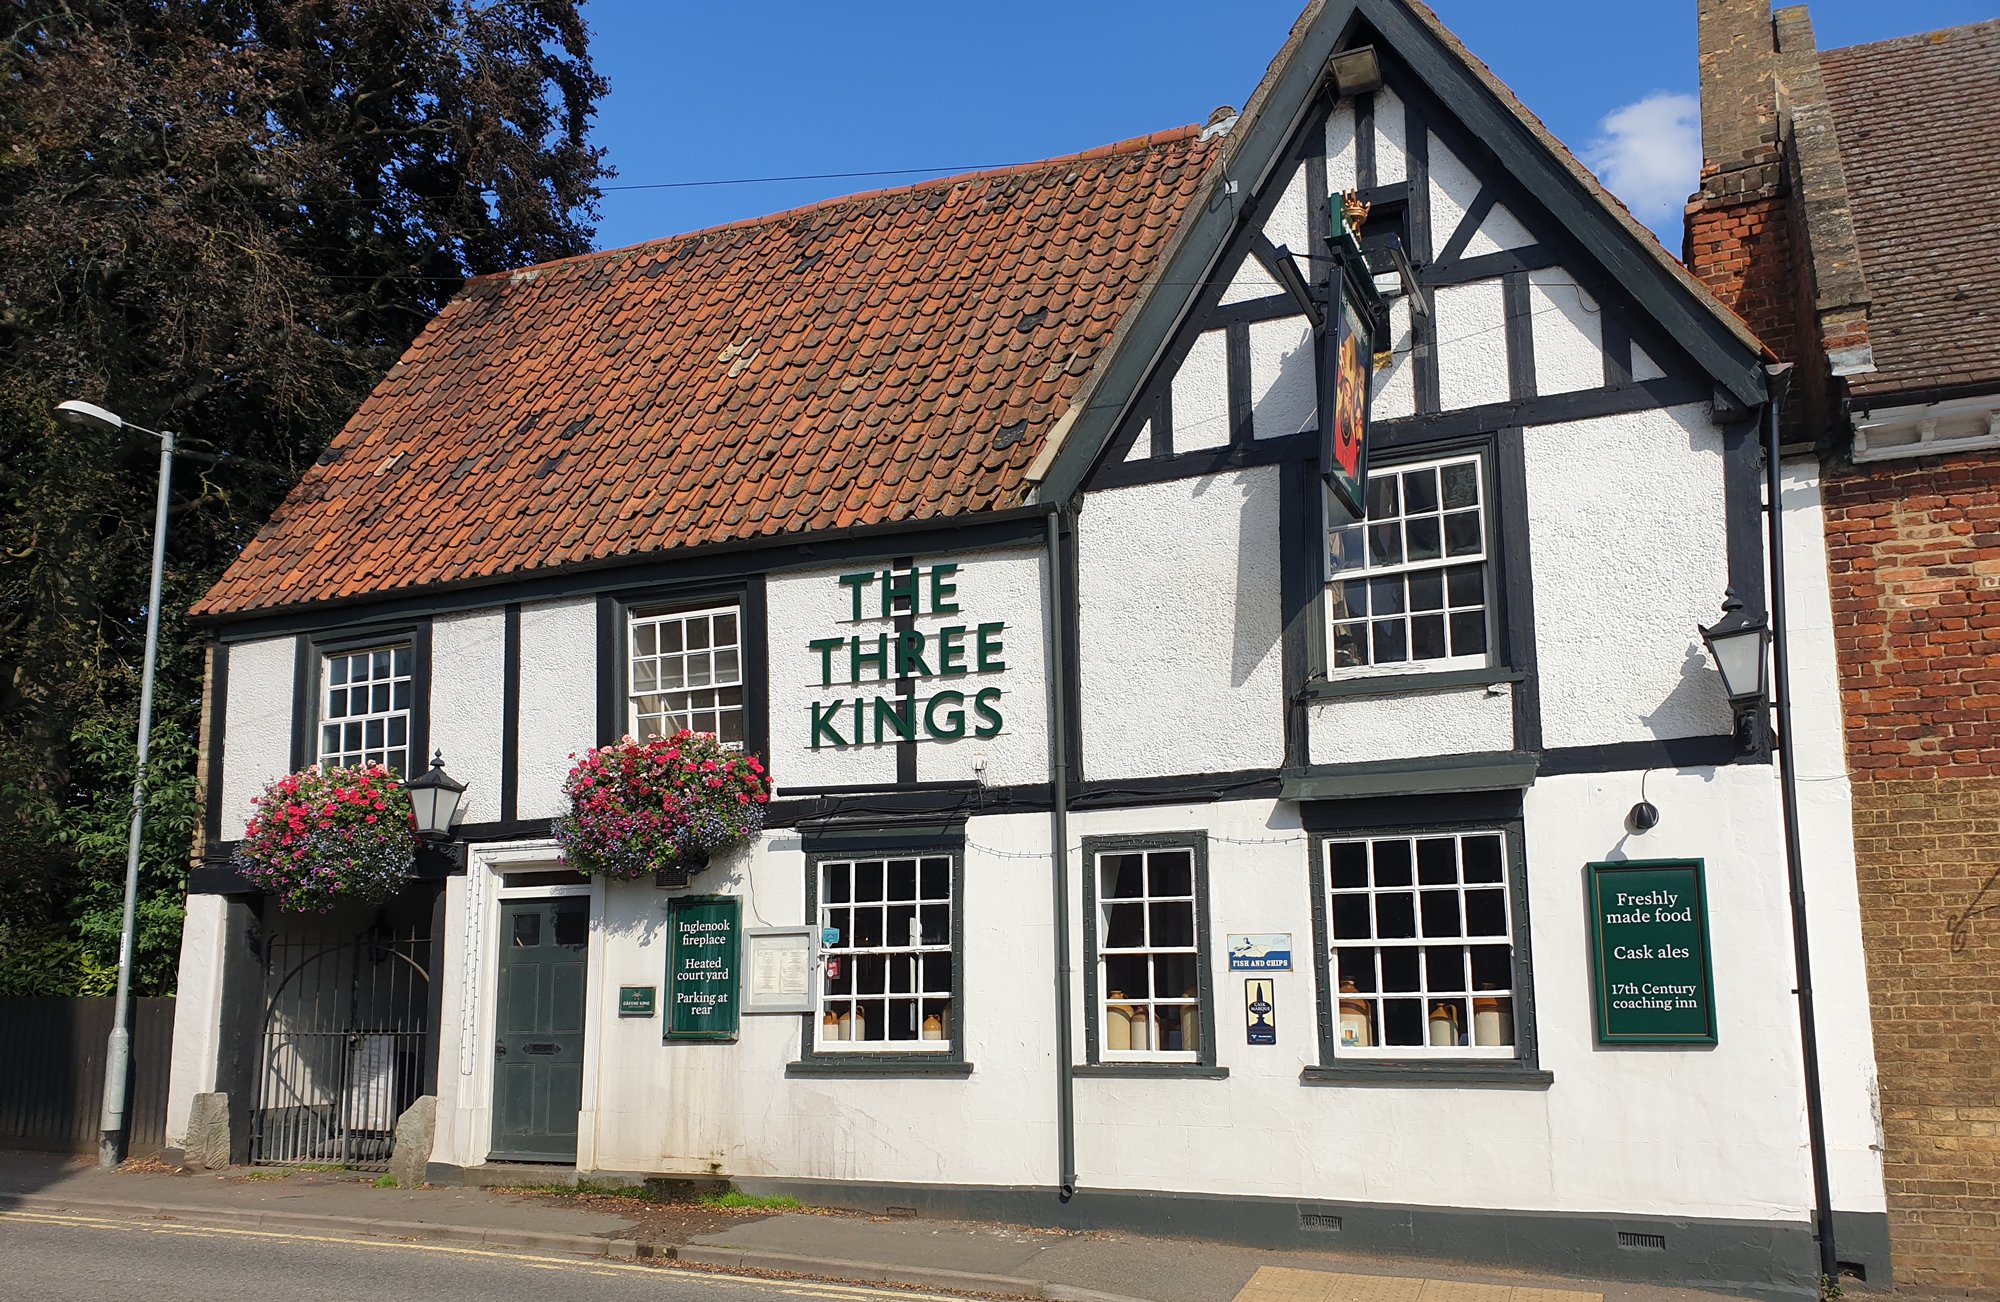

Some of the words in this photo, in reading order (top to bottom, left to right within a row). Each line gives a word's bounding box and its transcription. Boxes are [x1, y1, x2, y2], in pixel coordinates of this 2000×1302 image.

[838, 563, 959, 621] THE
[809, 622, 1005, 686] THREE
[811, 687, 1003, 748] KINGS
[1616, 890, 1678, 907] Freshly
[1606, 908, 1650, 923] made
[1655, 907, 1692, 922] food
[679, 919, 730, 934] Inglenook
[682, 933, 726, 947] fireplace
[1613, 944, 1654, 960] Cask
[1657, 944, 1690, 959] ales
[685, 956, 722, 969] Heated
[1266, 959, 1288, 967] CHIPS
[677, 971, 704, 980] court
[706, 968, 729, 982] yard
[1611, 982, 1639, 995] 17th
[1641, 983, 1697, 997] Century
[676, 991, 717, 1006] Parking
[717, 993, 729, 1003] at
[1612, 996, 1673, 1012] coaching
[1675, 996, 1698, 1009] inn
[691, 1006, 713, 1015] rear
